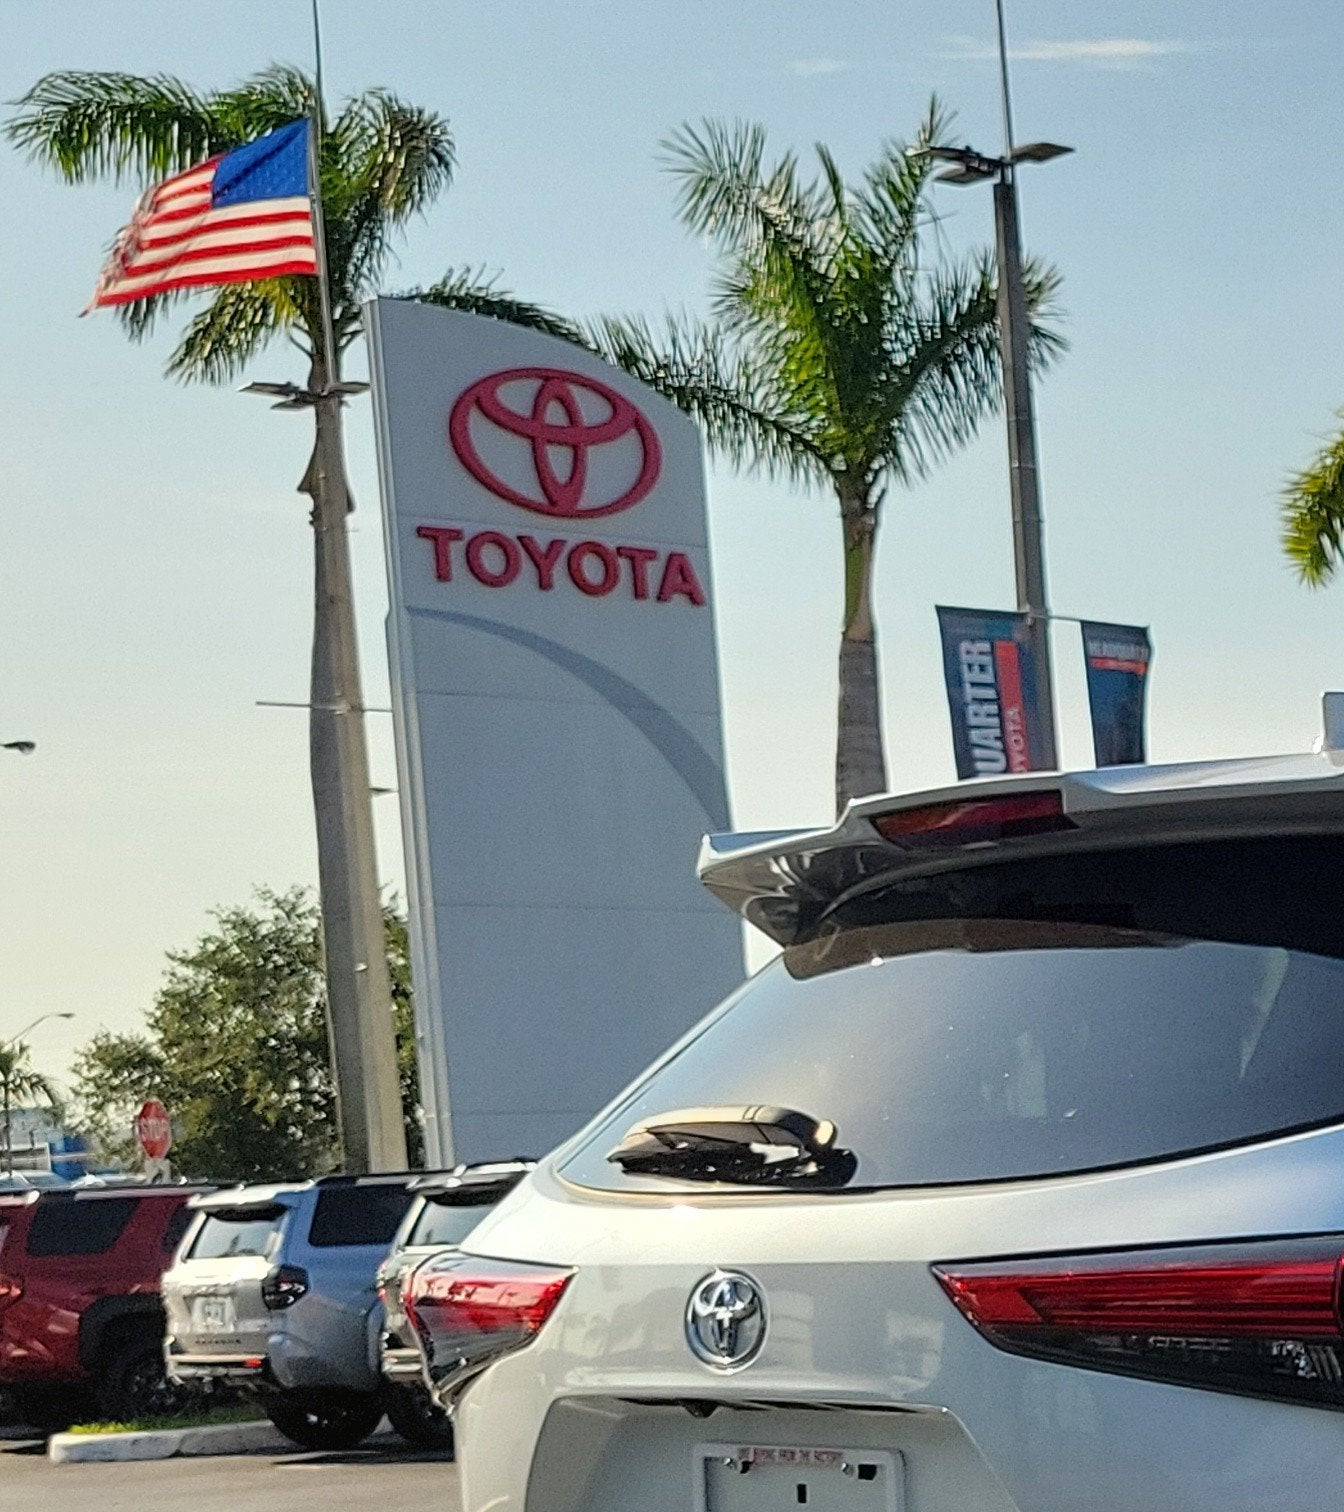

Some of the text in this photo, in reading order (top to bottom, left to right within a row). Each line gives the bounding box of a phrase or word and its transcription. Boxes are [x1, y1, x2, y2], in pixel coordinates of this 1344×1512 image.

[416, 525, 706, 607] TOYOTA
[959, 639, 1008, 777] UARTER
[140, 1116, 168, 1140] STOP
